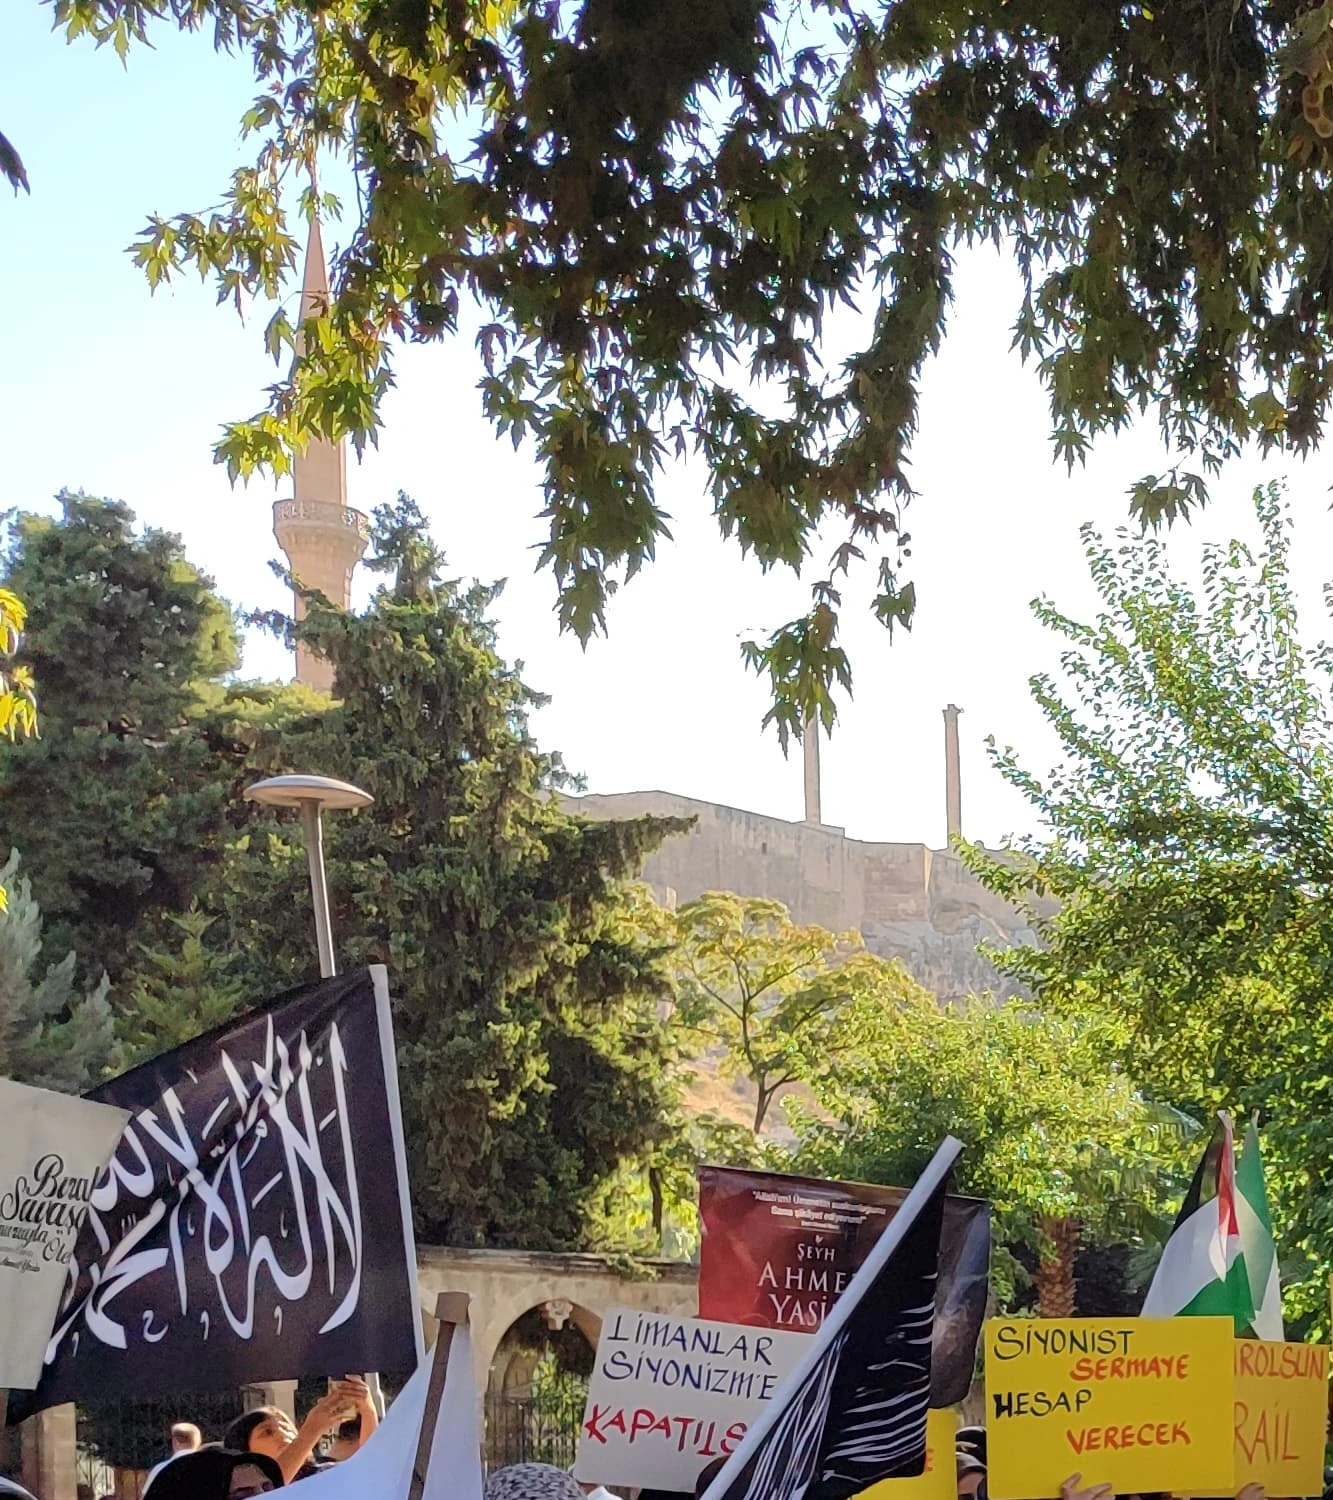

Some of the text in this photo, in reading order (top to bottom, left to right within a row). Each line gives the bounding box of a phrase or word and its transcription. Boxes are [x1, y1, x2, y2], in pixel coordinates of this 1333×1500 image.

[757, 1261, 858, 1294] AHME
[768, 1293, 836, 1327] YASİ
[607, 1313, 774, 1366] LİMANLAR
[993, 1324, 1136, 1361] SİYONİST
[1068, 1353, 1192, 1382] SERMAYE
[992, 1389, 1093, 1420] HESAP
[1066, 1419, 1193, 1456] VERECEK
